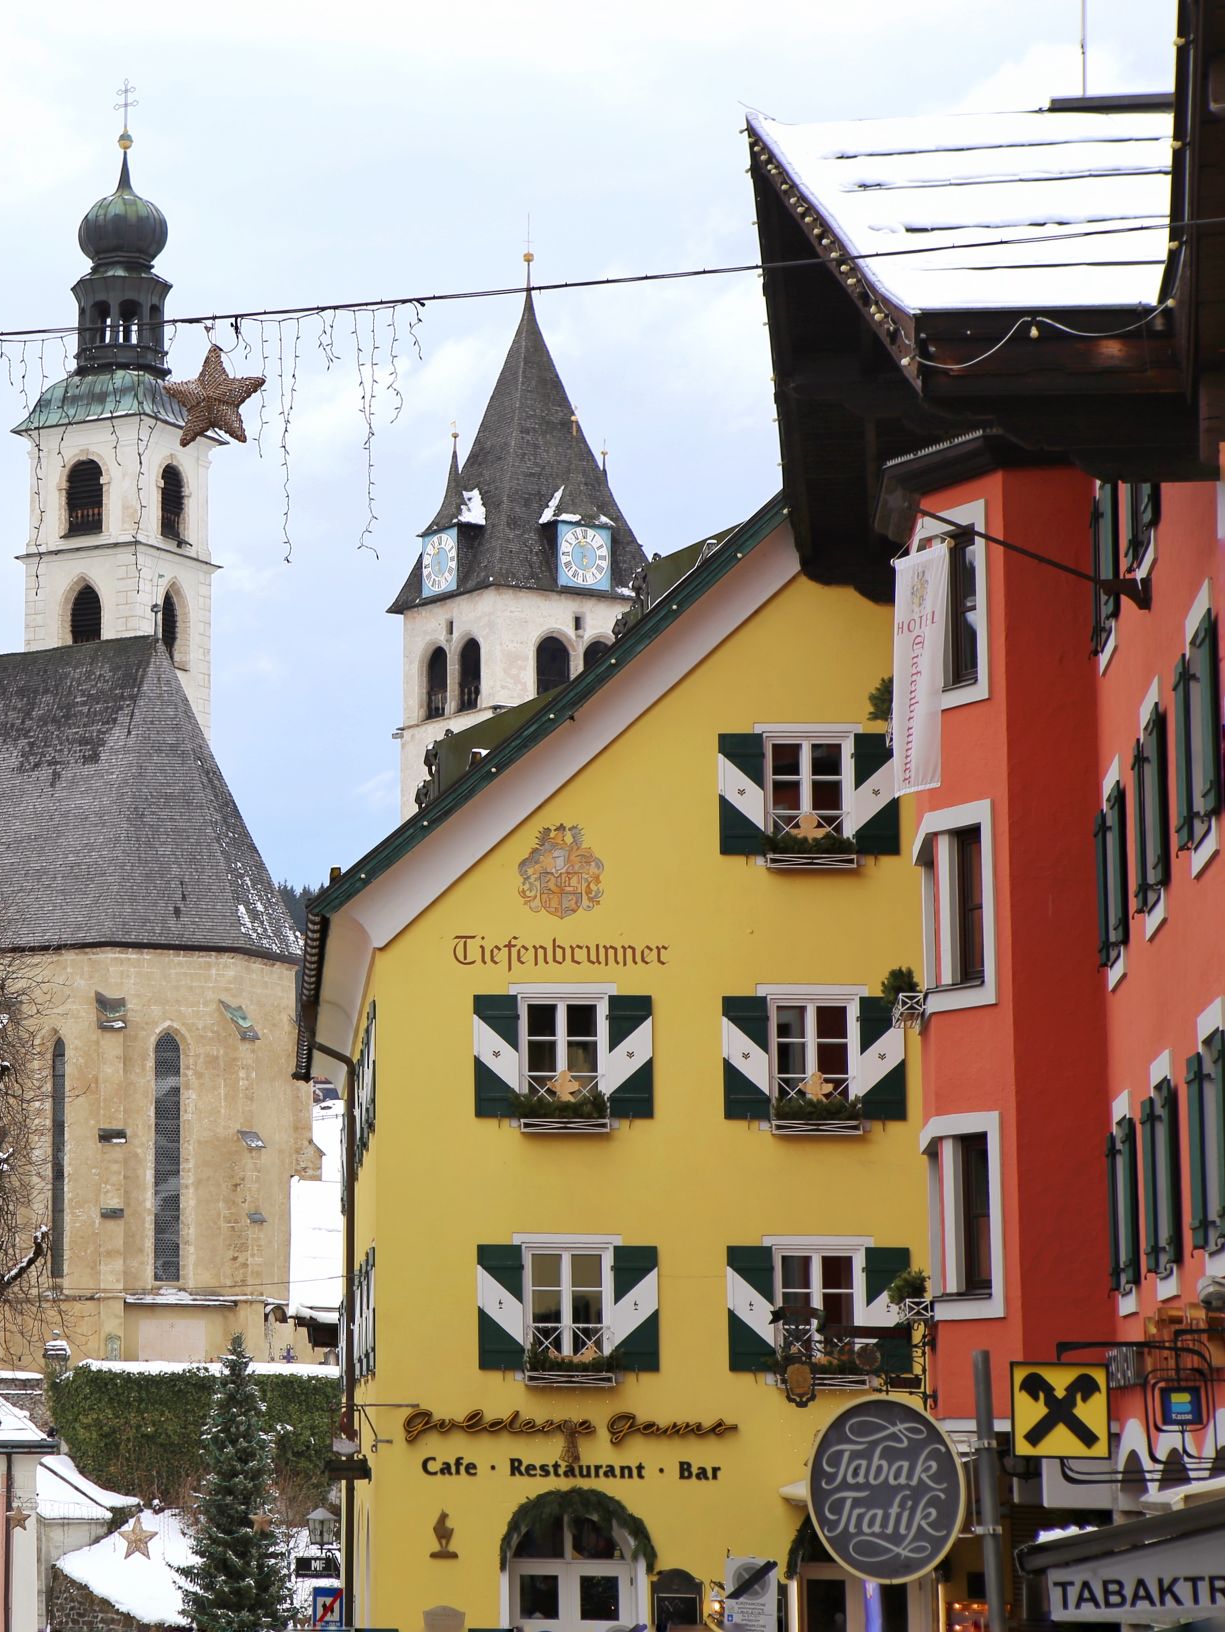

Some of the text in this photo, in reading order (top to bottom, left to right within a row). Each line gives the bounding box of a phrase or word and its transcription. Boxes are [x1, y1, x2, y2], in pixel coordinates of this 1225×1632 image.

[897, 610, 937, 635] HOTEL
[453, 935, 670, 973] Tiefenbrunner
[607, 1411, 738, 1445] Gams
[421, 1457, 721, 1480] Cafe Restaurant Bar
[822, 1443, 948, 1489] Tabak
[824, 1491, 948, 1537] Trafik
[311, 1560, 326, 1571] MF
